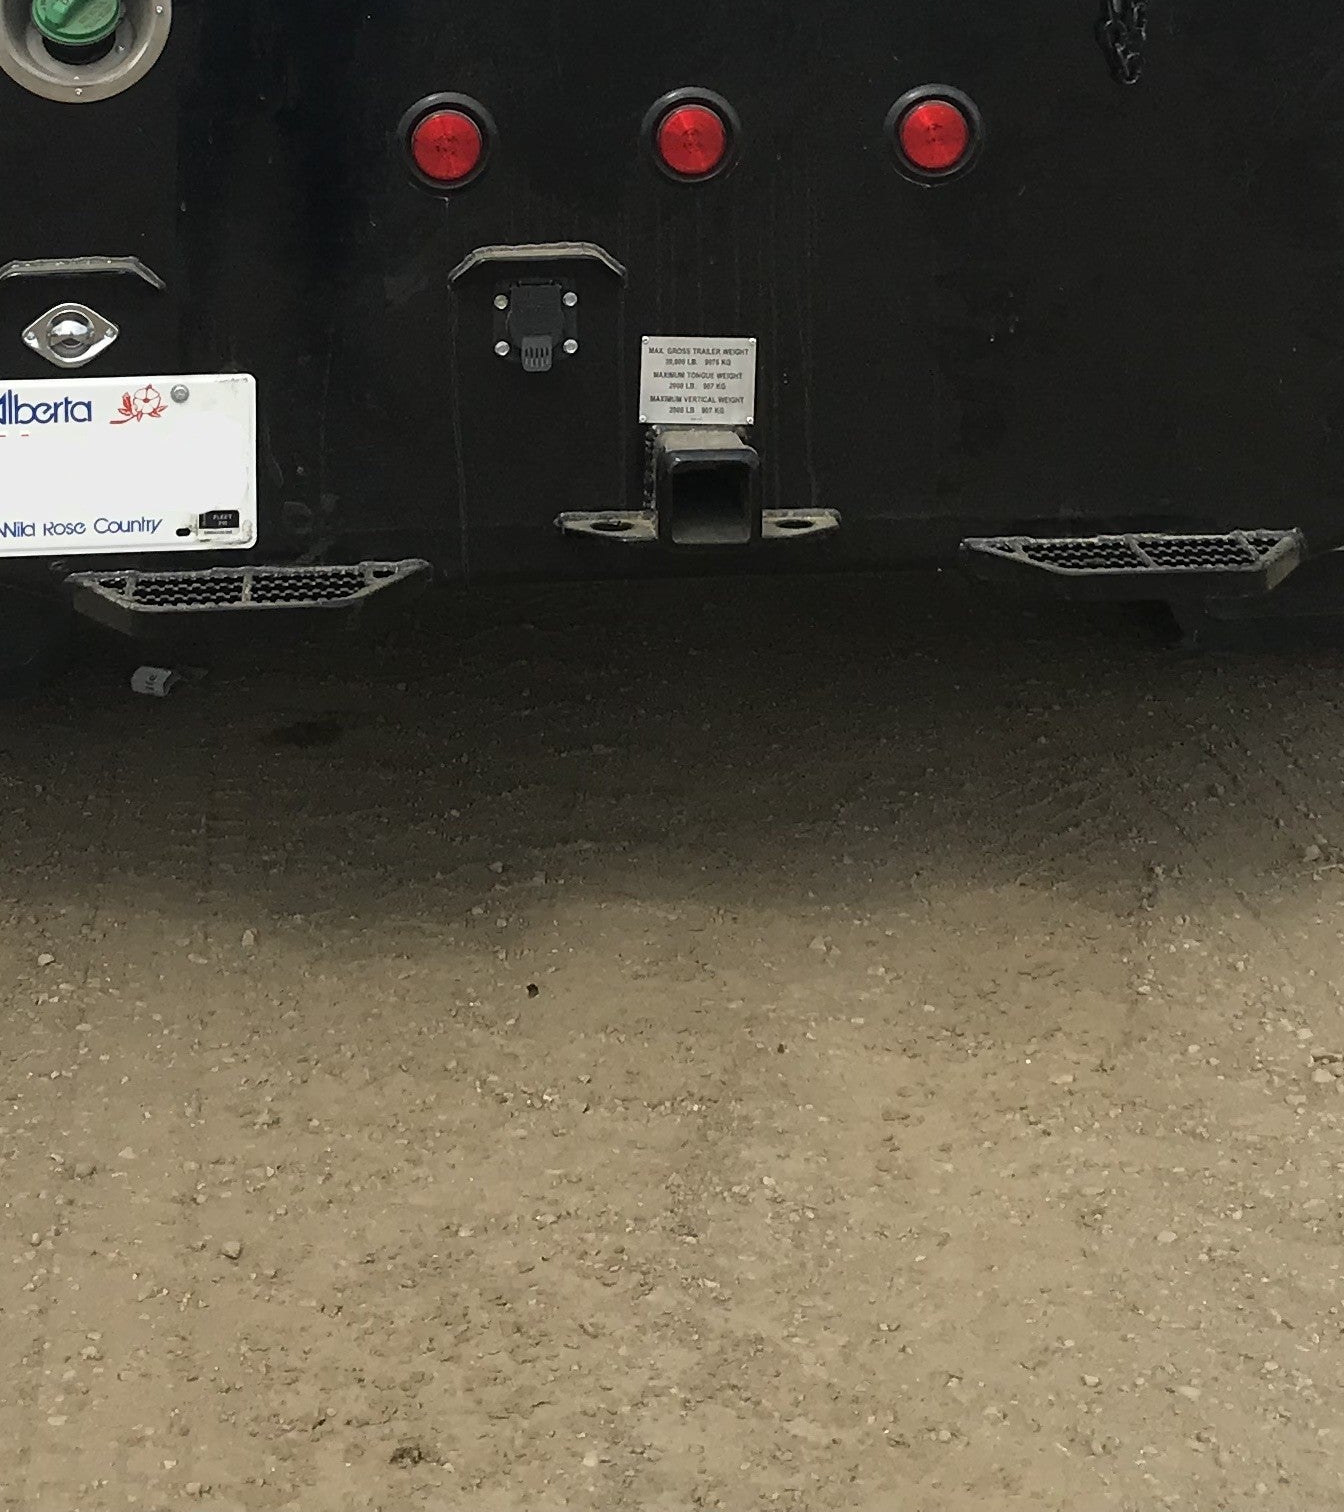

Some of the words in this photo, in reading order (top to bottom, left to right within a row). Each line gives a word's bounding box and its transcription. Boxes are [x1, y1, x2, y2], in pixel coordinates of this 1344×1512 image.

[666, 347, 690, 355] GROSS
[722, 348, 749, 356] WEIGHT
[721, 358, 732, 366] KG
[716, 382, 727, 390] KG
[684, 396, 716, 404] VERTICAL
[718, 396, 744, 404] WEIGHT
[715, 407, 725, 415] KG
[42, 521, 87, 537] Rose
[93, 516, 164, 535] Country
